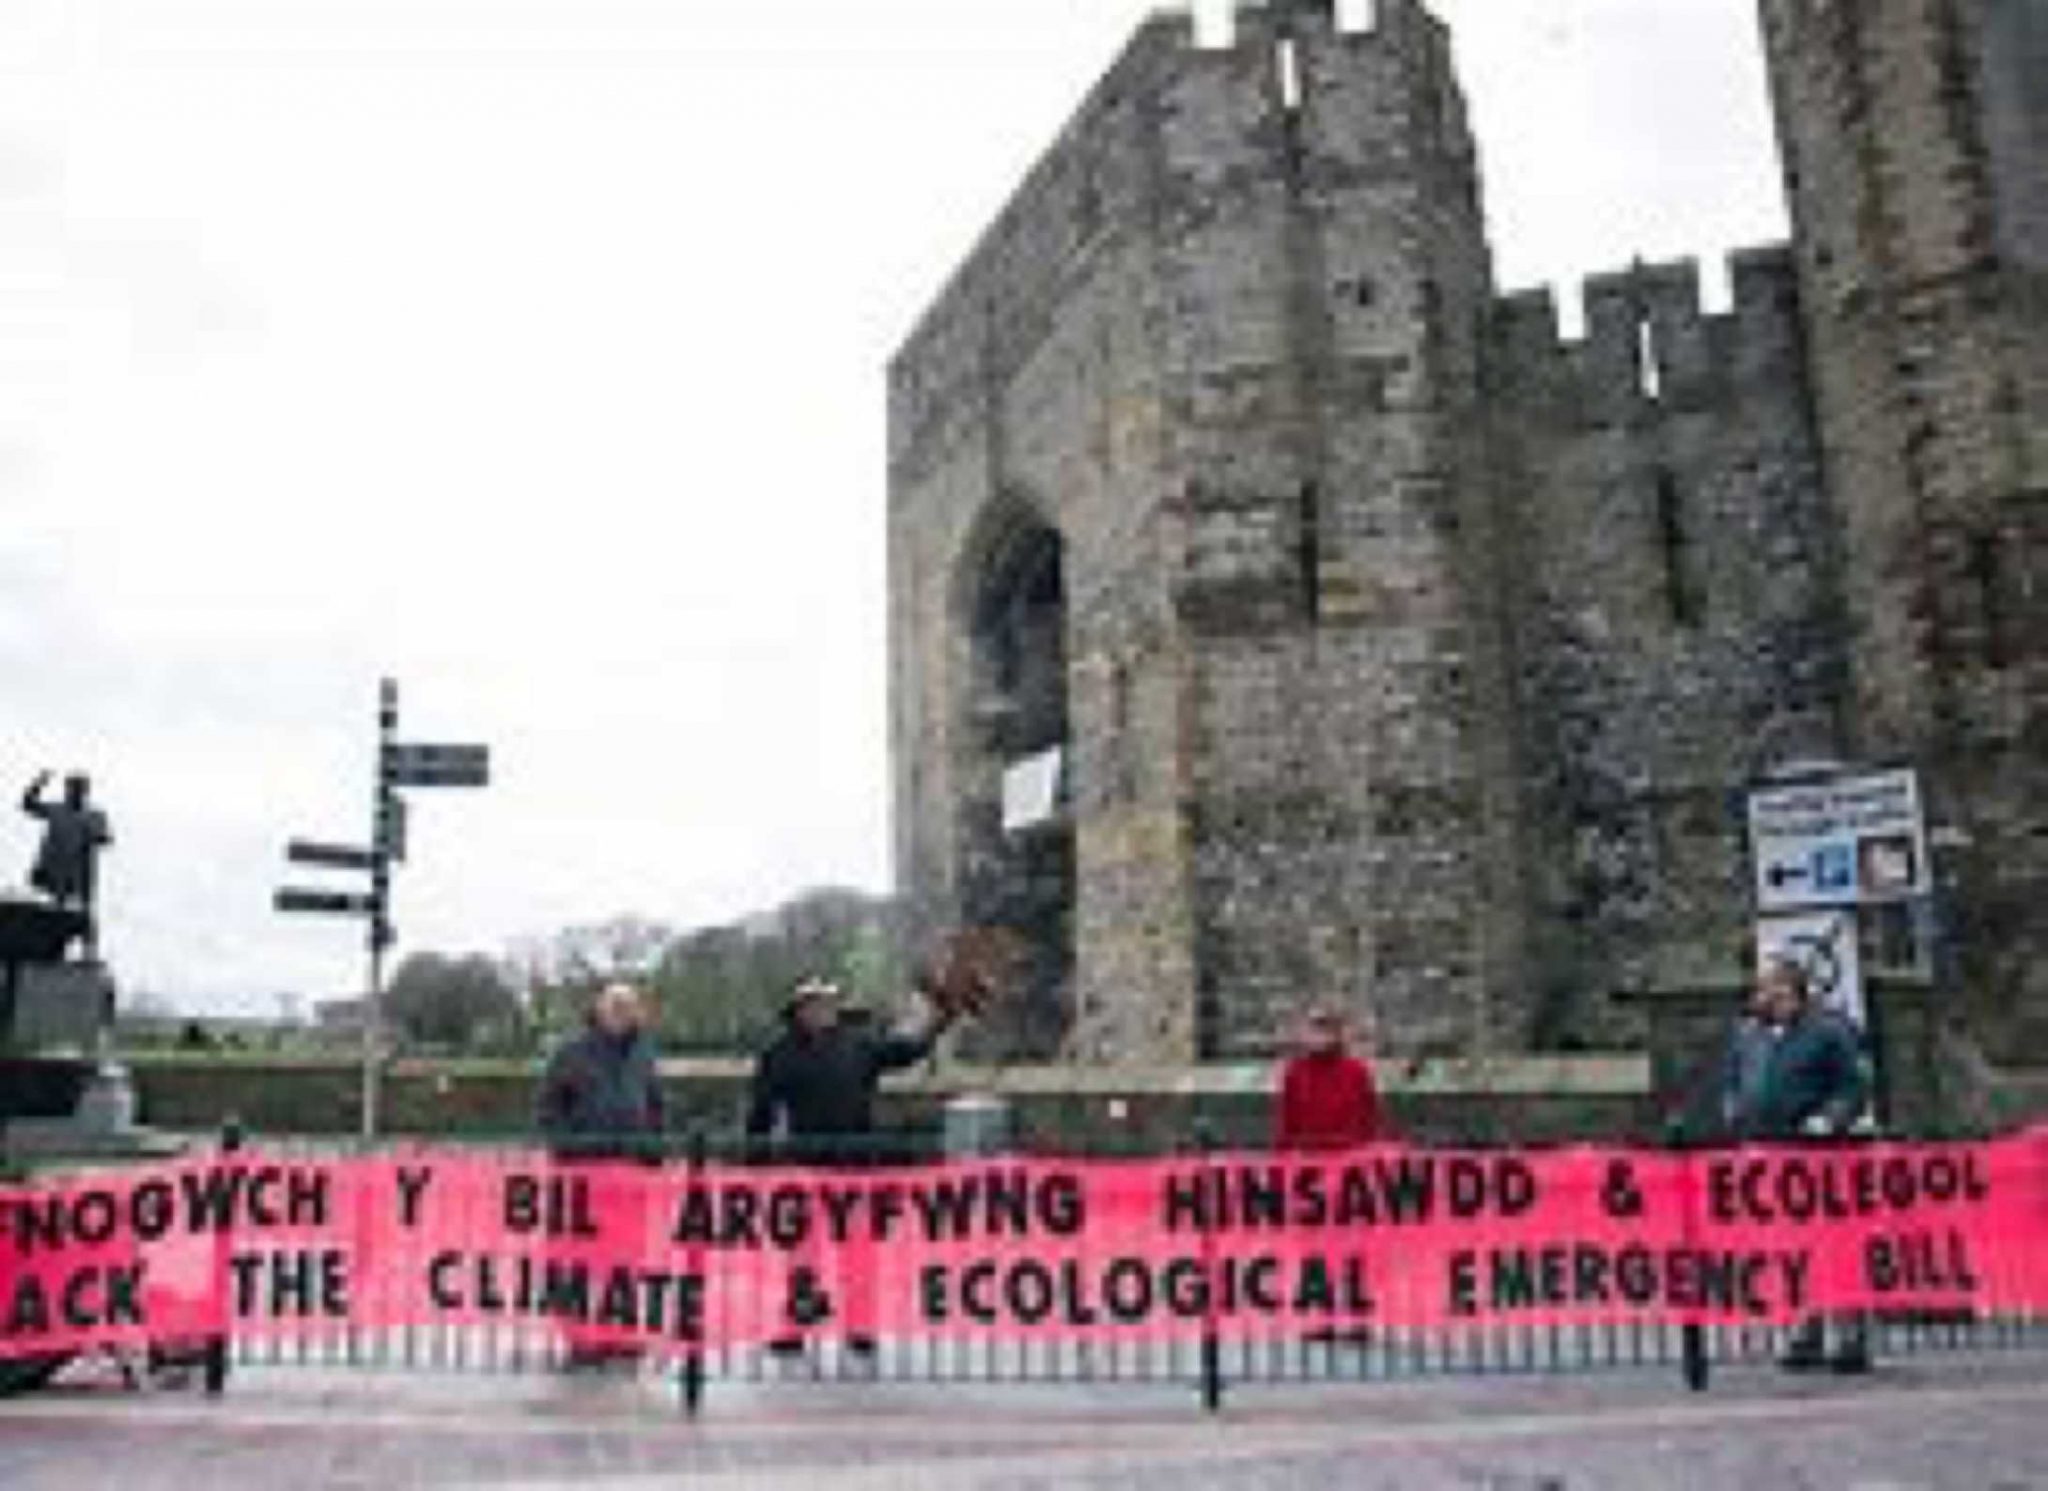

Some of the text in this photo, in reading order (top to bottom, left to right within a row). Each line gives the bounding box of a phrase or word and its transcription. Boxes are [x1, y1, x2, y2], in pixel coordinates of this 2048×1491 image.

[0, 1151, 1988, 1252] NOGWCH Y BIL ARGYFWNG HINSAWDD & ECOLEGOL
[231, 1250, 348, 1317] THE
[429, 1251, 704, 1341] CLIMATE
[786, 1265, 832, 1325] &
[920, 1256, 1374, 1326] ECOLOGICAL
[1450, 1244, 1808, 1316] EMERGENCY
[1866, 1228, 1978, 1293] BILL
